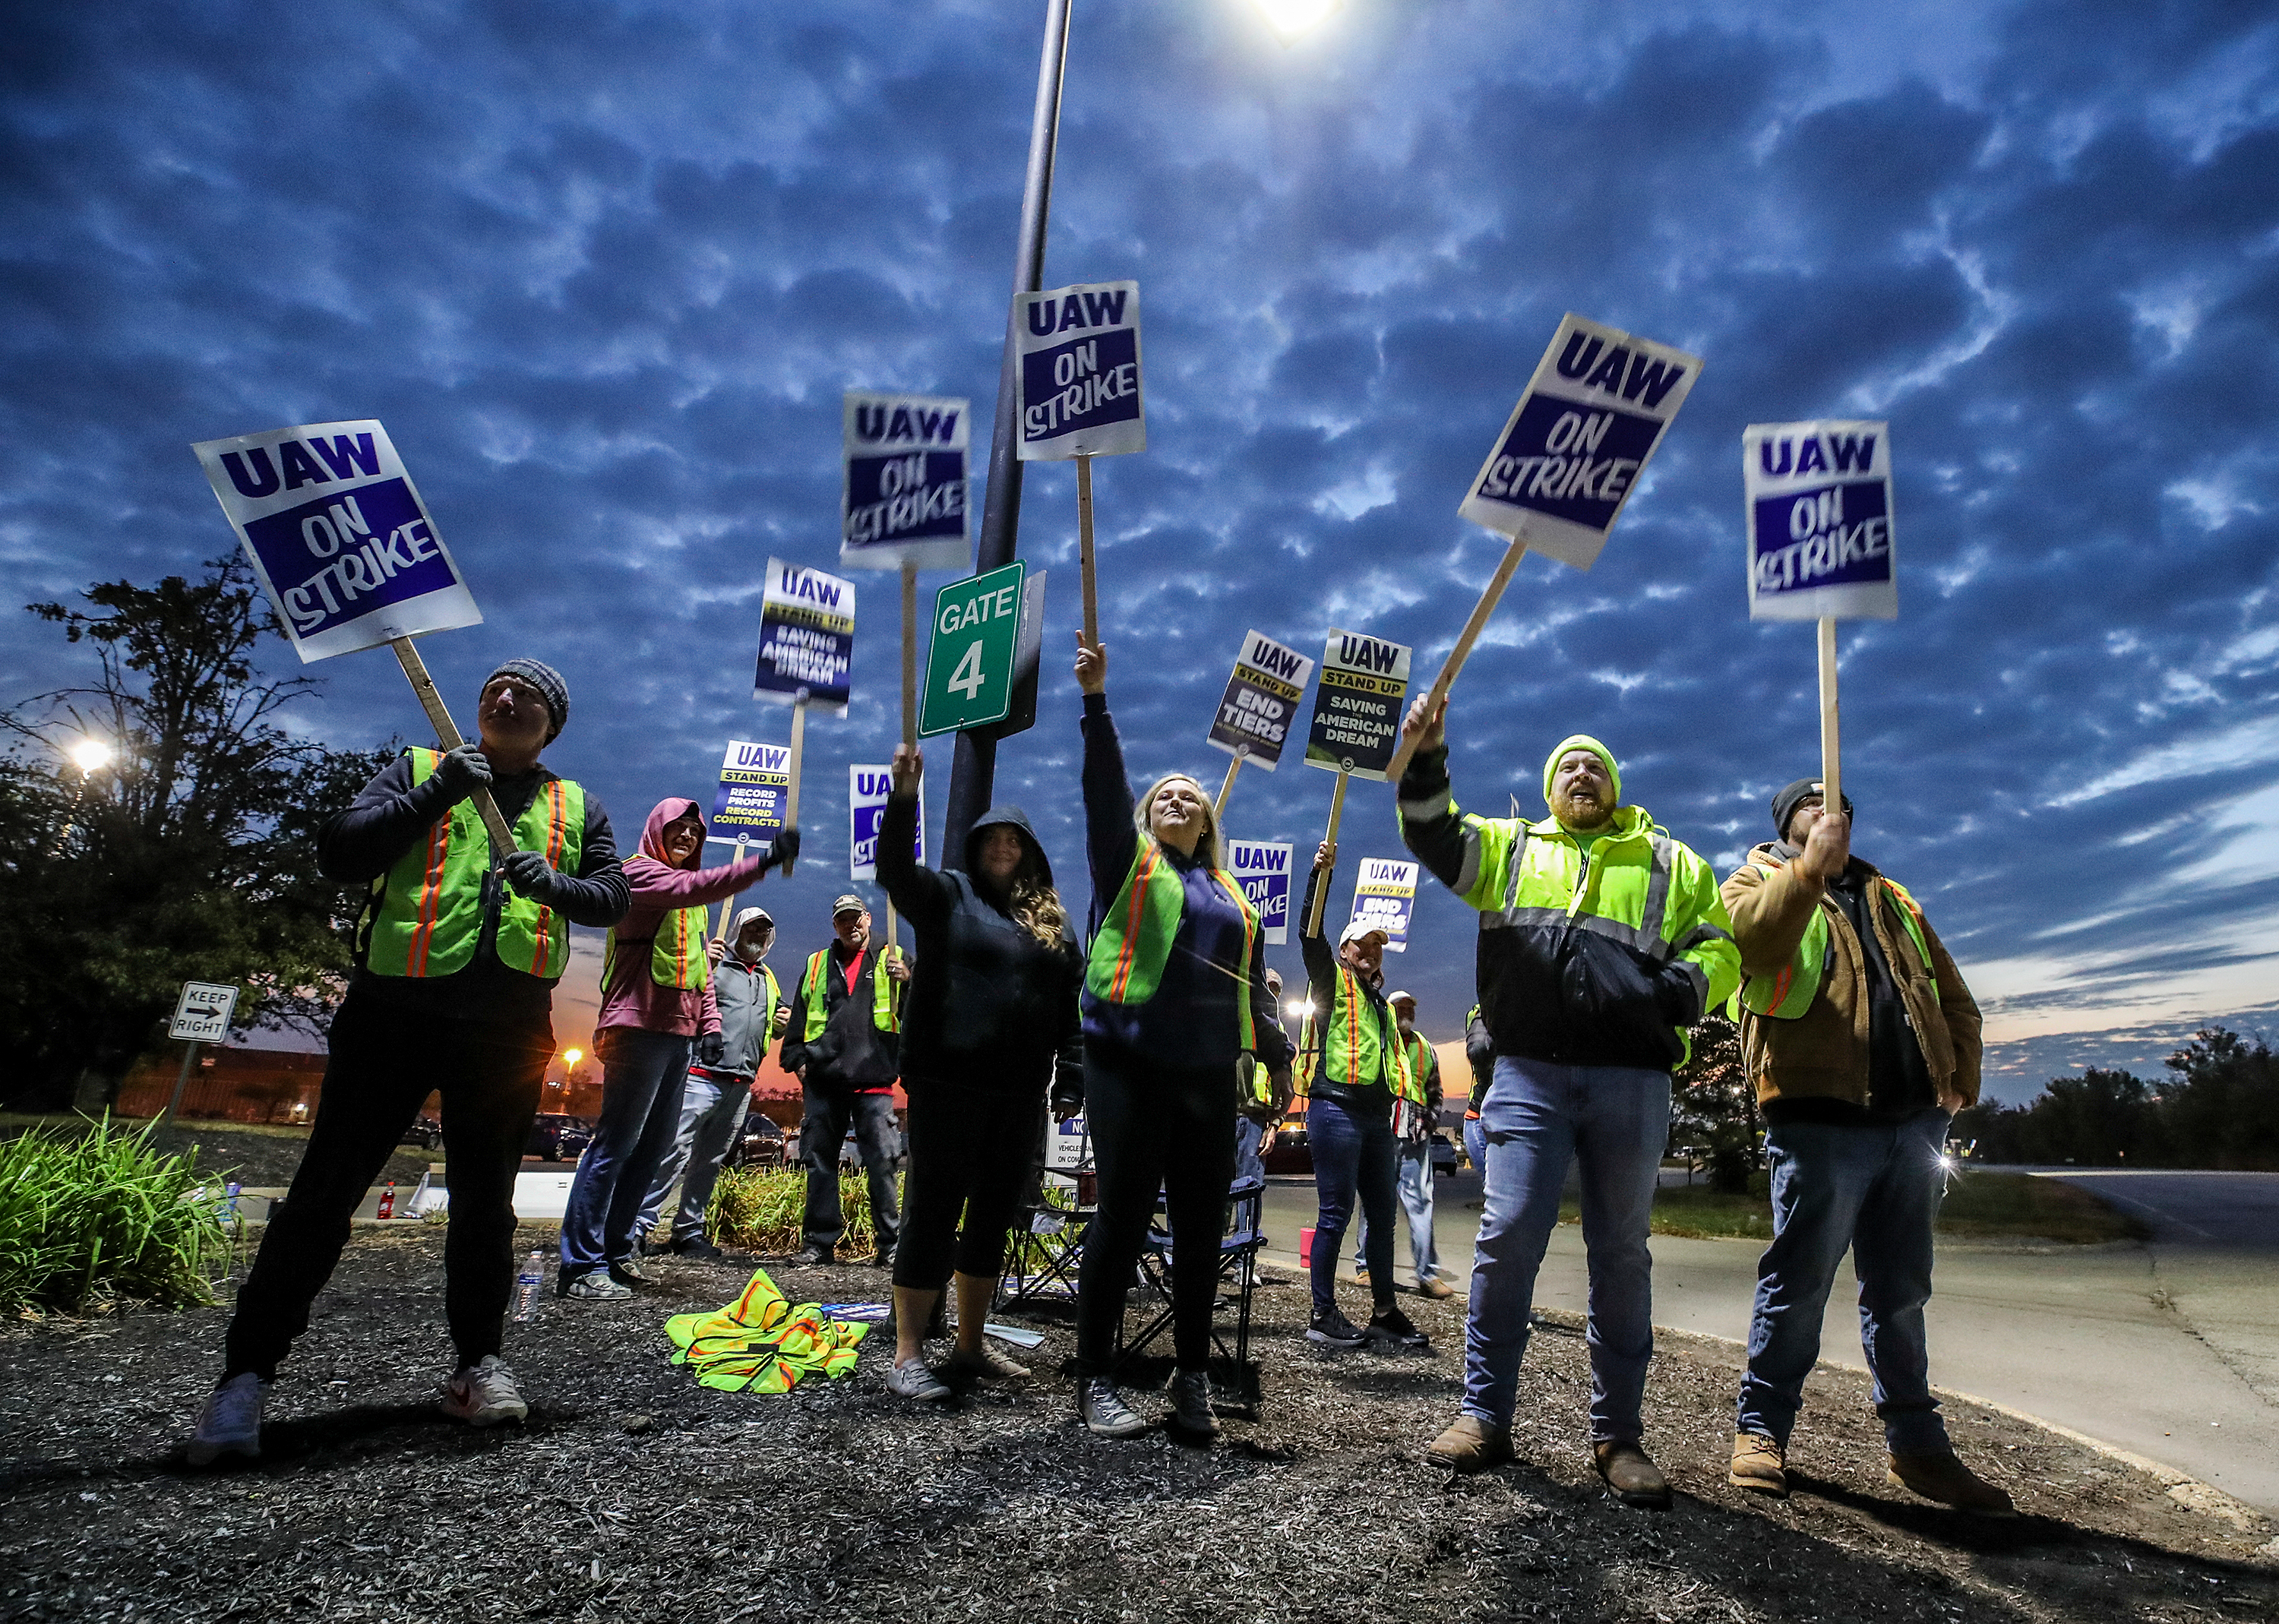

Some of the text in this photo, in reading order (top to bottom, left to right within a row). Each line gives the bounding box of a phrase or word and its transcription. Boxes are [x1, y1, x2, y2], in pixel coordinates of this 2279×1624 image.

[1029, 290, 1127, 336] UAW
[1054, 340, 1097, 386] ON
[1556, 330, 1687, 409] UAW
[1026, 362, 1137, 438] STRIKE
[855, 403, 961, 443] UAW
[1546, 411, 1615, 456] ON
[220, 432, 381, 498] UAW
[879, 450, 927, 498] ON
[1761, 434, 1877, 476] UAW
[1482, 454, 1639, 501] STRIKE
[302, 495, 371, 558] ON
[846, 479, 964, 545] STRIKE
[1789, 484, 1844, 542] ON
[1756, 515, 1889, 591] STRIKE
[283, 519, 439, 632] STRIKE
[782, 565, 841, 607] UAW
[940, 585, 1015, 634] GATE
[947, 640, 985, 700] 4
[1253, 639, 1304, 681] UAW
[1339, 635, 1399, 674] UAW
[1326, 672, 1401, 694] STAND UP
[1223, 703, 1285, 743] TIERS
[1236, 687, 1284, 720] END
[1330, 695, 1386, 716] SAVING
[1315, 712, 1395, 738] AMERICAN
[1326, 728, 1380, 749] DREAM
[737, 745, 787, 769] UAW
[725, 772, 788, 784] STAND UP
[730, 787, 777, 799] RECORD
[858, 773, 891, 795] UA
[713, 814, 781, 827] CONTRACTS
[725, 806, 773, 817] RECORD
[727, 796, 776, 808] PROFITS
[872, 809, 884, 834] O
[1234, 847, 1288, 870] UAW
[1370, 863, 1408, 882] UAW
[1245, 877, 1269, 902] ON
[1362, 897, 1402, 914] END
[188, 991, 228, 1003] KEEP
[175, 1019, 222, 1033] RIGHT
